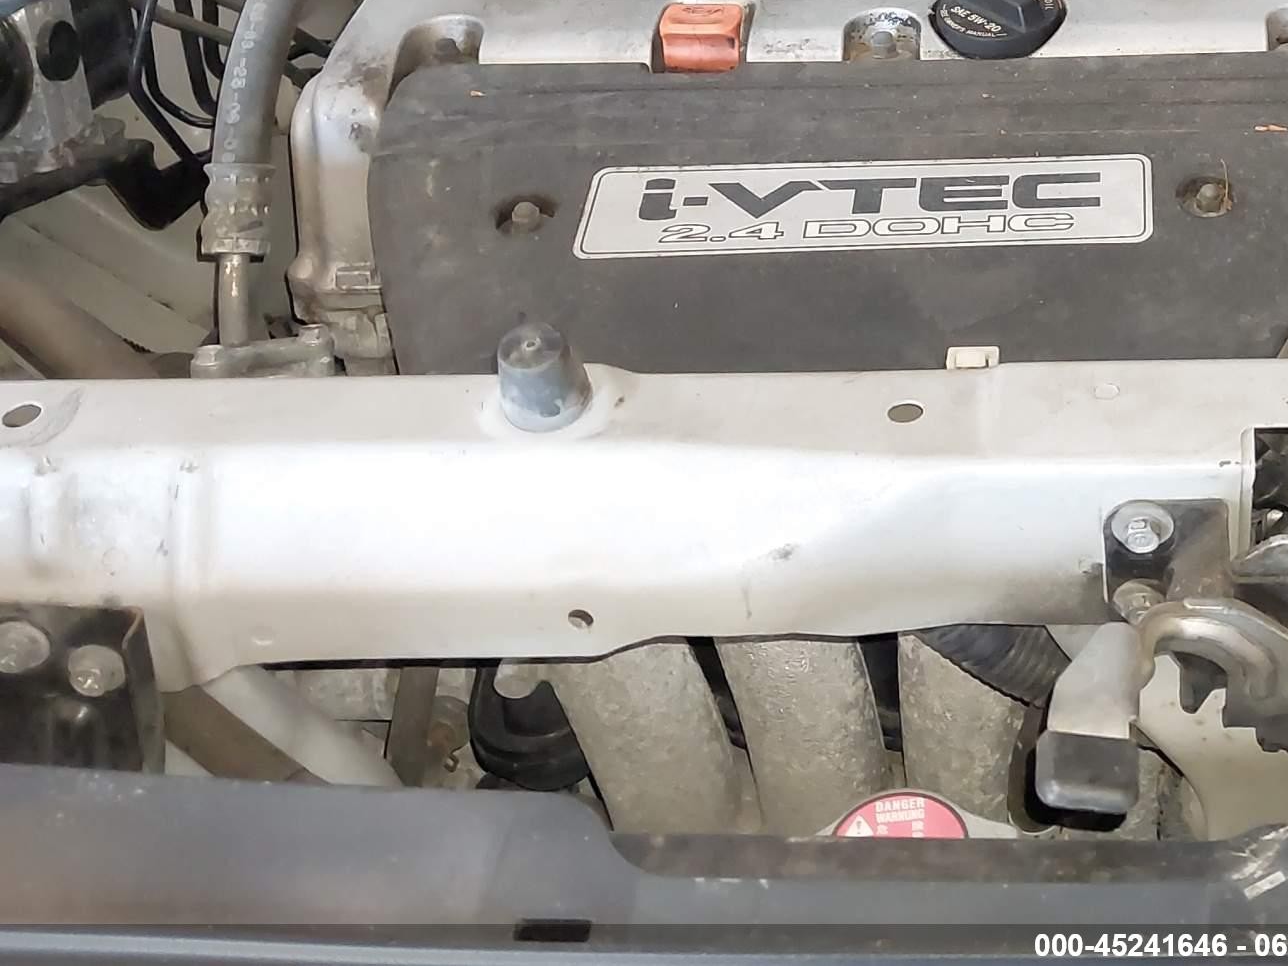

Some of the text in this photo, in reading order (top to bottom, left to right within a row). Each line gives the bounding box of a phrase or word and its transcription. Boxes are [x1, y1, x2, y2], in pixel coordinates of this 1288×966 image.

[951, 6, 1002, 32] SAE 5W-20
[638, 172, 1101, 221] i-VTEC
[659, 212, 1075, 244] 2.4 DOHC
[875, 797, 925, 812] DANGER
